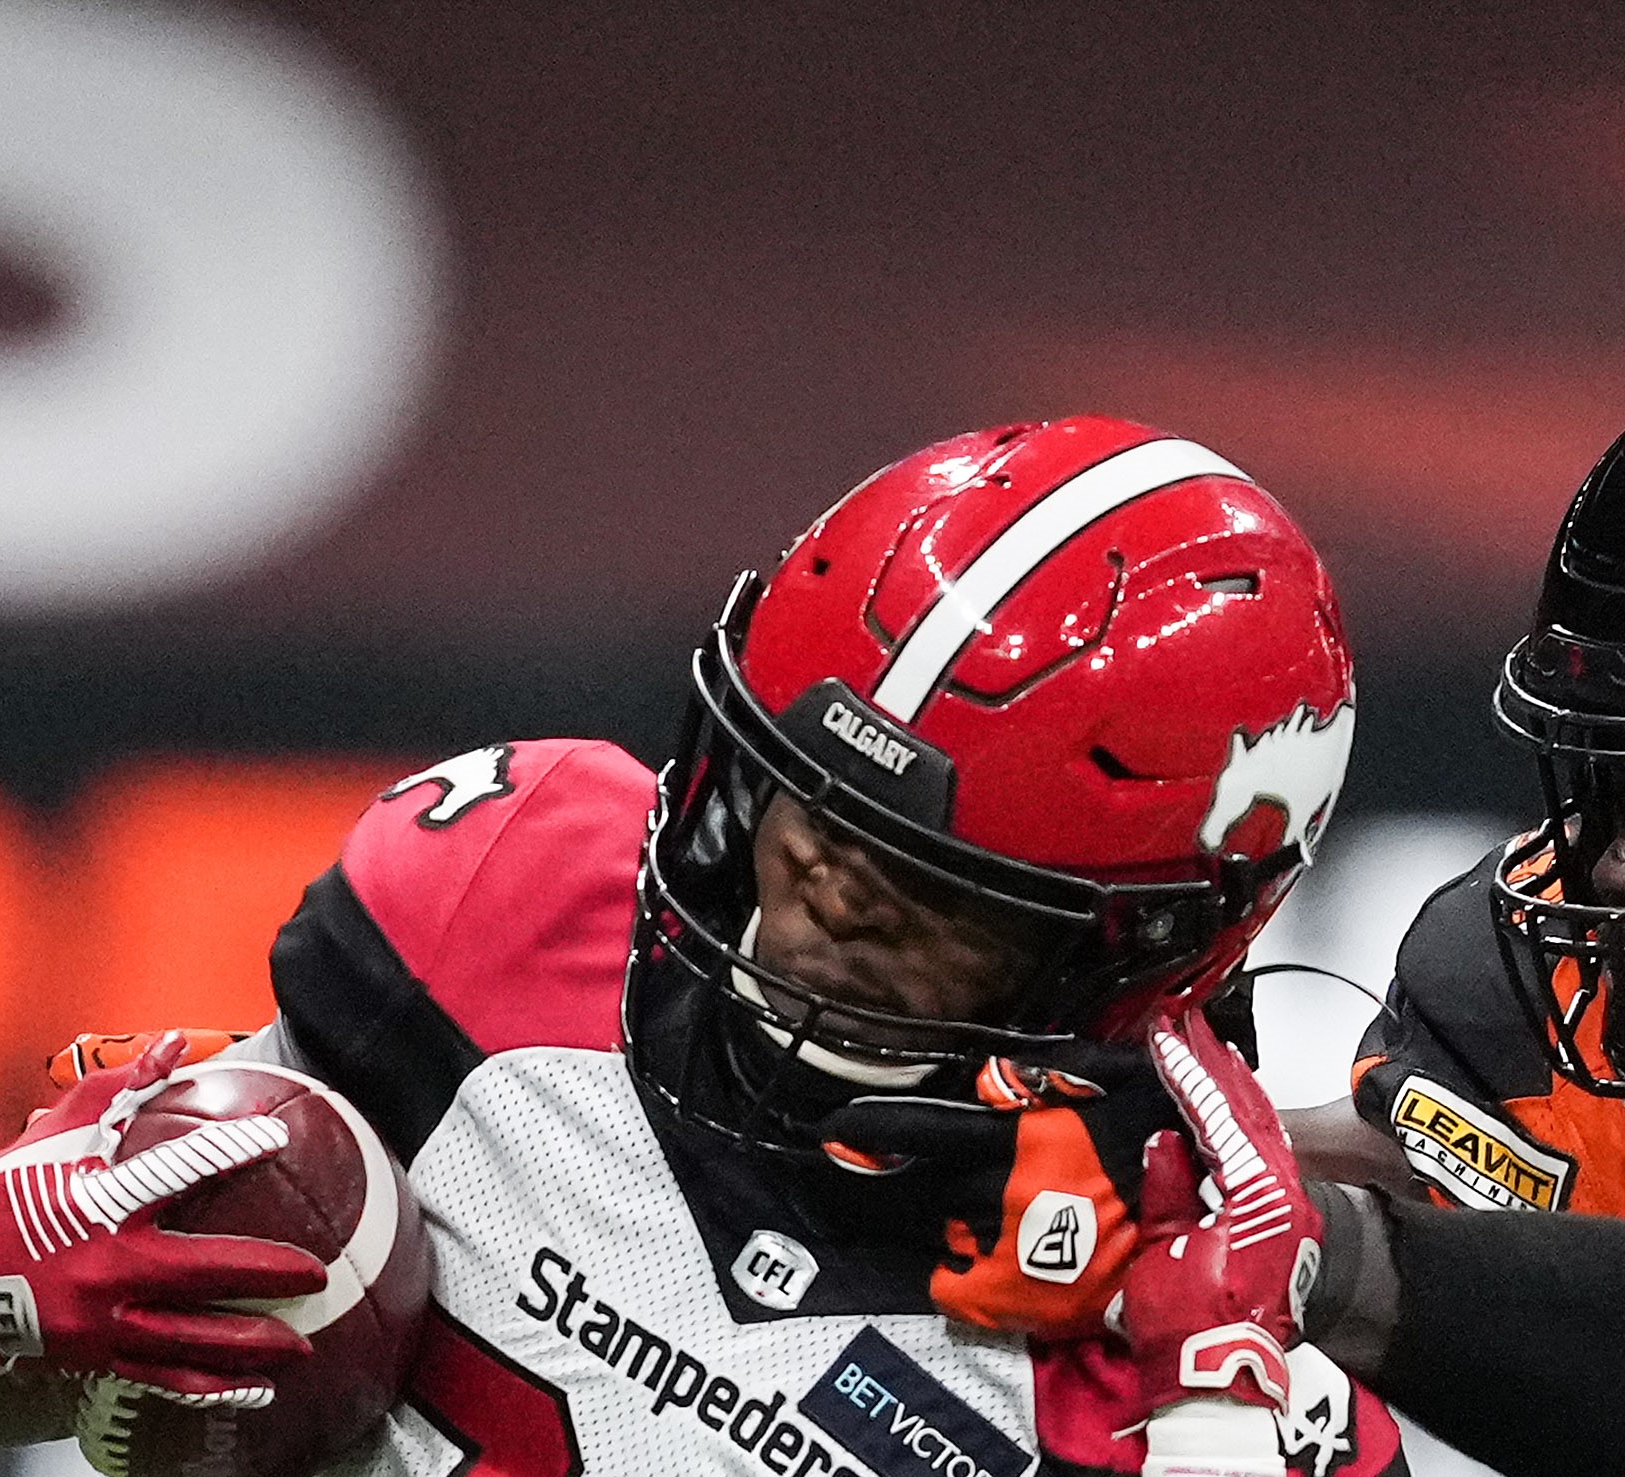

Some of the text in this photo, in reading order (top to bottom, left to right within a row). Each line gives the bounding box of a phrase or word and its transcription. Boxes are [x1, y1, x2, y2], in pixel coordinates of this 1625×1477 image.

[822, 701, 918, 776] CALGARY
[1402, 1097, 1550, 1202] LEAVITT
[748, 1250, 796, 1296] CFL
